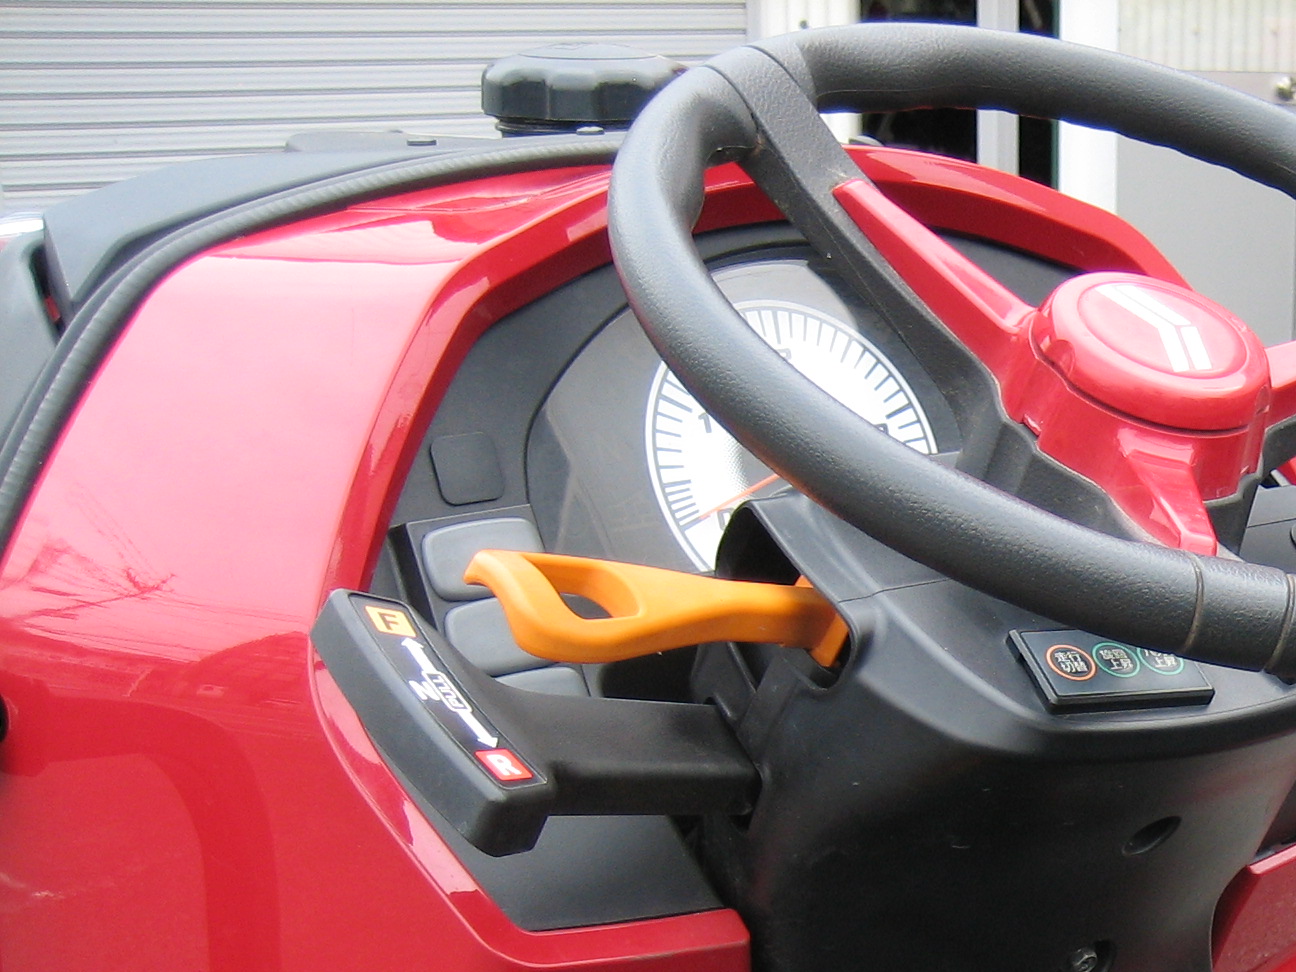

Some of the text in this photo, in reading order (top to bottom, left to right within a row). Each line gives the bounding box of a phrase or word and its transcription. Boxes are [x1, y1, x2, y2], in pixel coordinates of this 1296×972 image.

[377, 611, 400, 631] F
[408, 680, 440, 701] N
[431, 674, 466, 708] PULL
[486, 753, 523, 776] R
